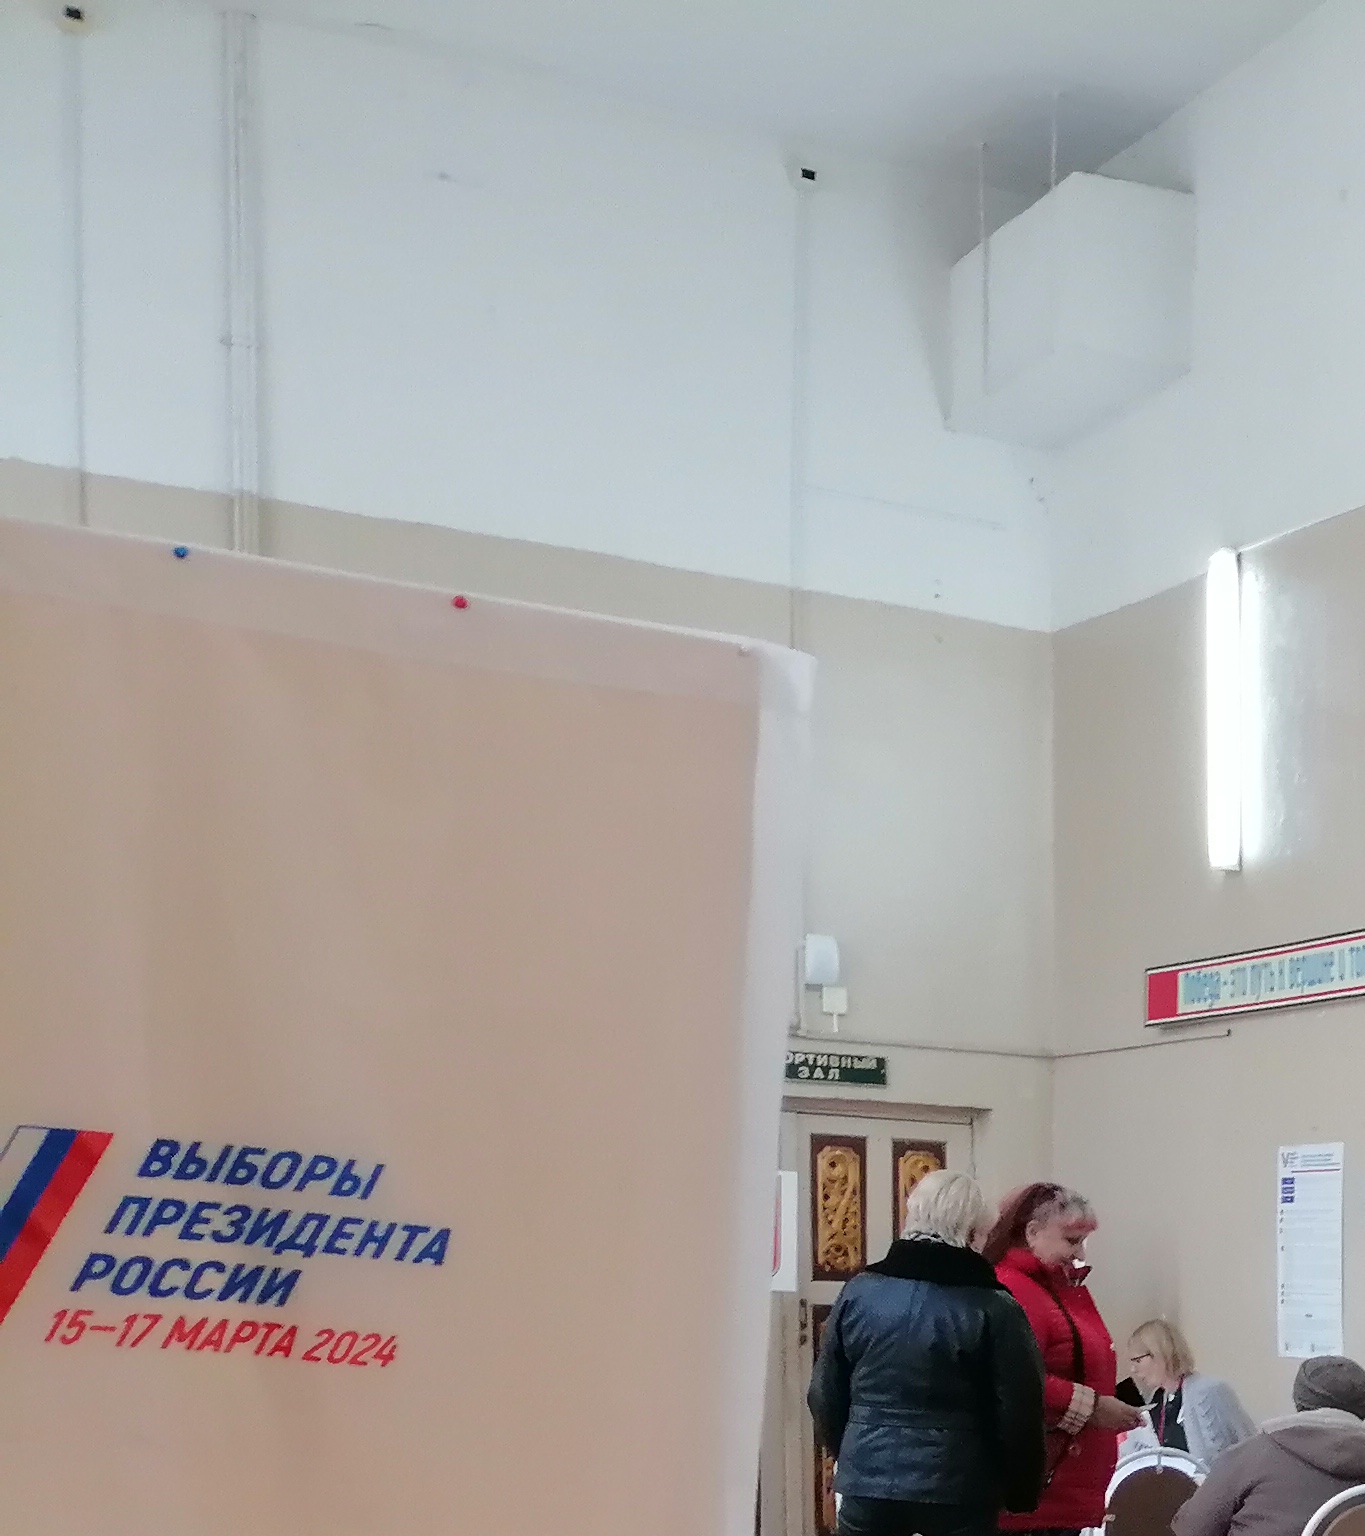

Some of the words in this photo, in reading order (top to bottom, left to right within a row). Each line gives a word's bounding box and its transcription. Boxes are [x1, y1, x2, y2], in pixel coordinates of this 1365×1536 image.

[785, 1051, 877, 1069] ОРТИВНЫЙ
[798, 1066, 840, 1080] ЗАЛ
[138, 1138, 386, 1199] ВЫБОРЫ
[103, 1195, 452, 1266] ПРЕЗИДЕНТА
[69, 1252, 302, 1307] РОССИИ
[161, 1316, 299, 1358] МАРТА
[302, 1328, 398, 1368] 2024
